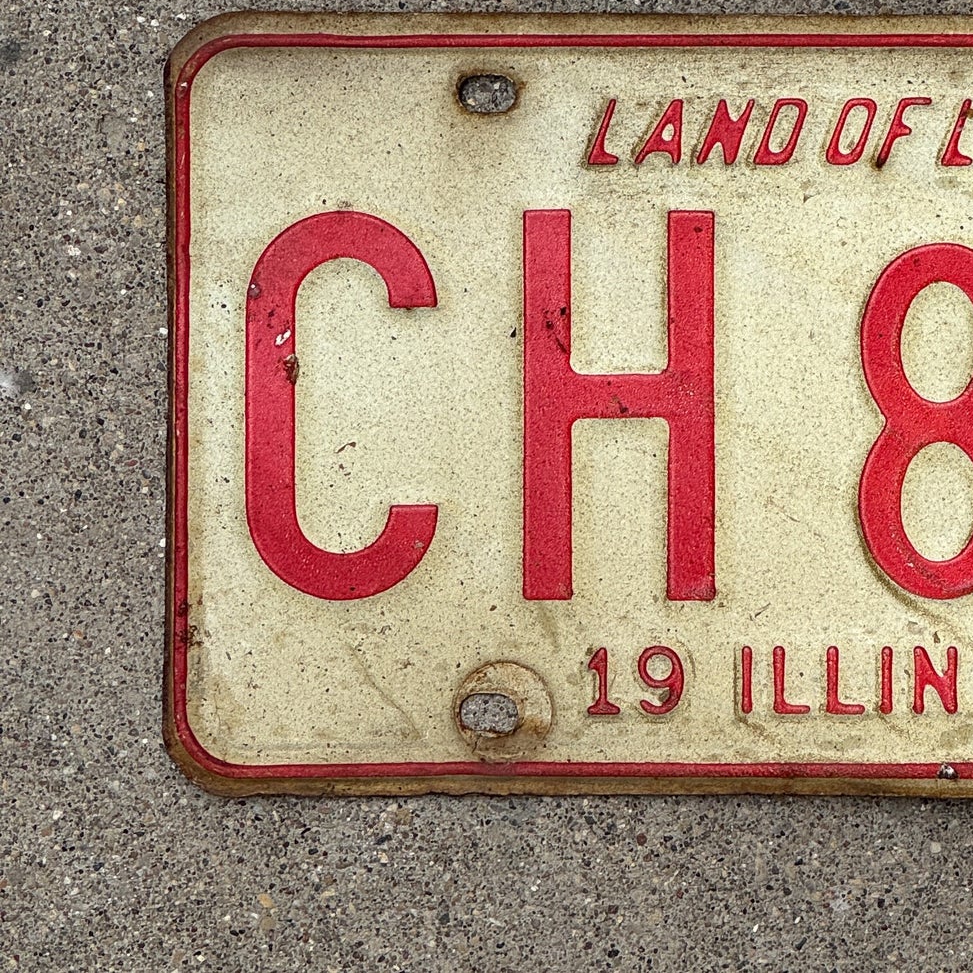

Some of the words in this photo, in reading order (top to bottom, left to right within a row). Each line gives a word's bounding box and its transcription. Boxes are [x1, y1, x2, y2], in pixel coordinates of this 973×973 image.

[587, 97, 809, 166] LAND
[824, 96, 933, 167] OF
[243, 208, 718, 602] CH
[587, 645, 686, 716] 19
